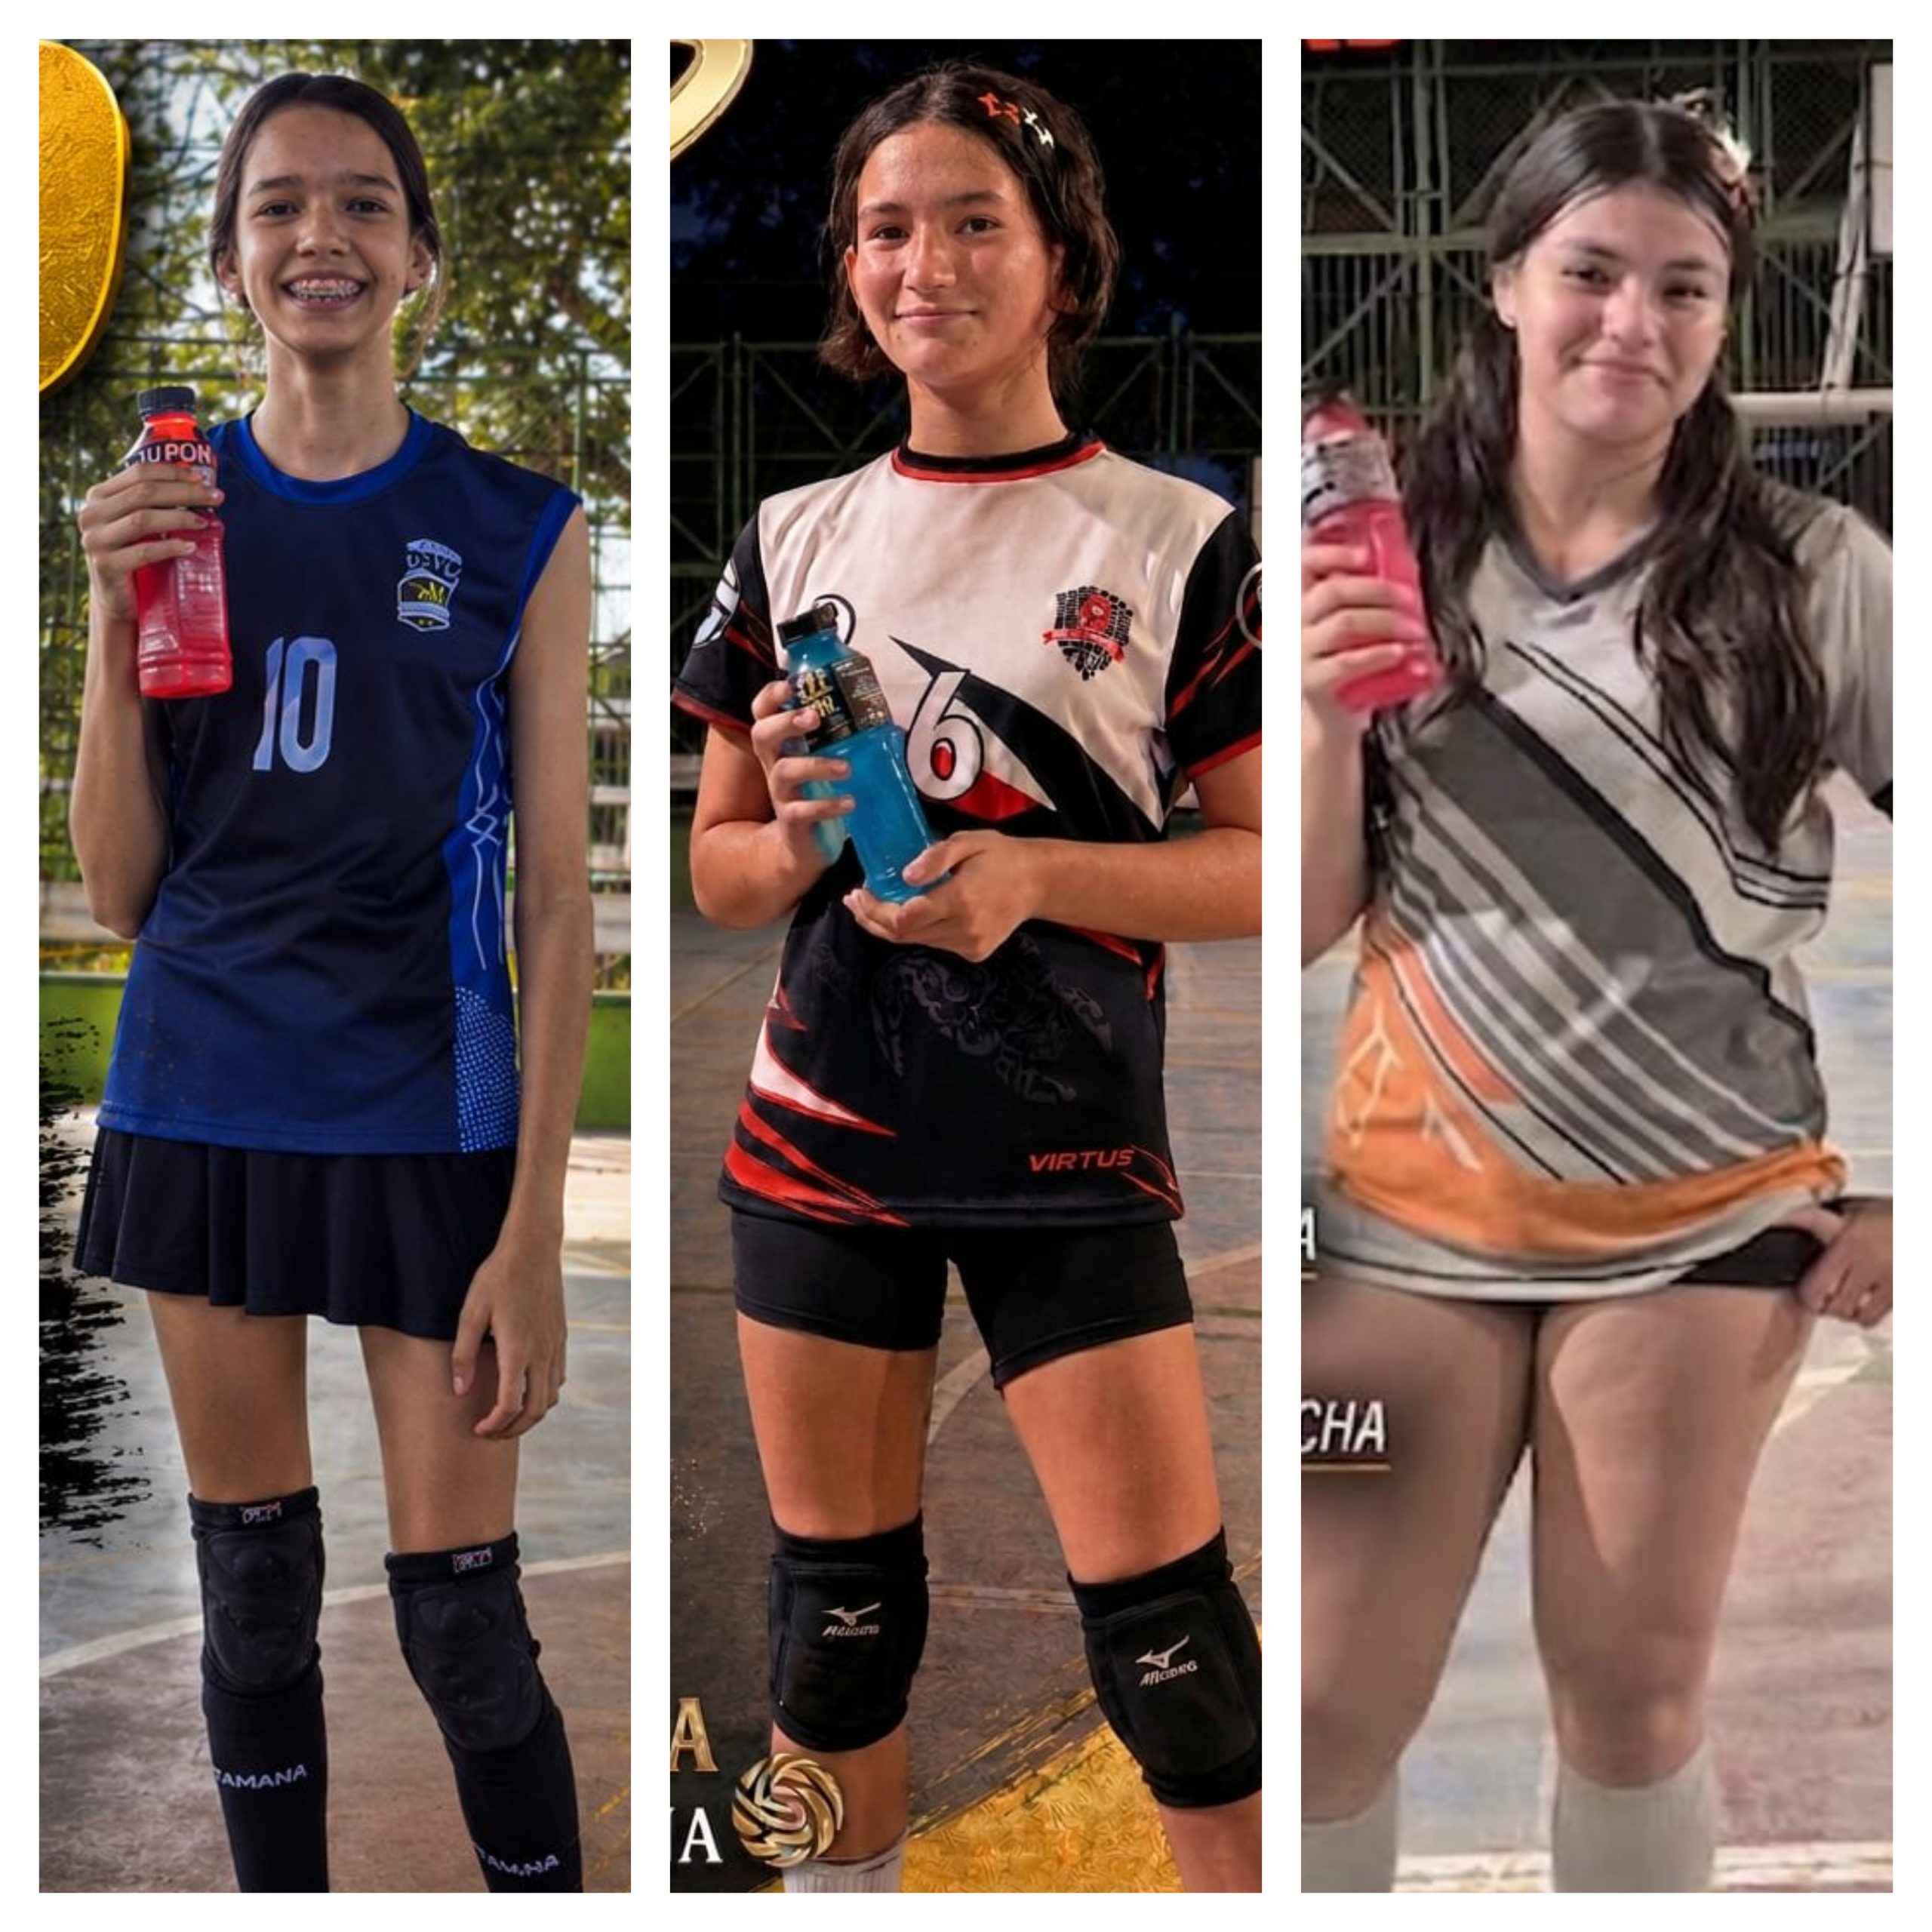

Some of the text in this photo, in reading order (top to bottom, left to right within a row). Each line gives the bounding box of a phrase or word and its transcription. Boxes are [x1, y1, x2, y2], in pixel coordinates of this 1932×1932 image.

[252, 636, 337, 773] 10
[905, 669, 984, 801] 6
[1029, 1149, 1134, 1171] VIRTUS
